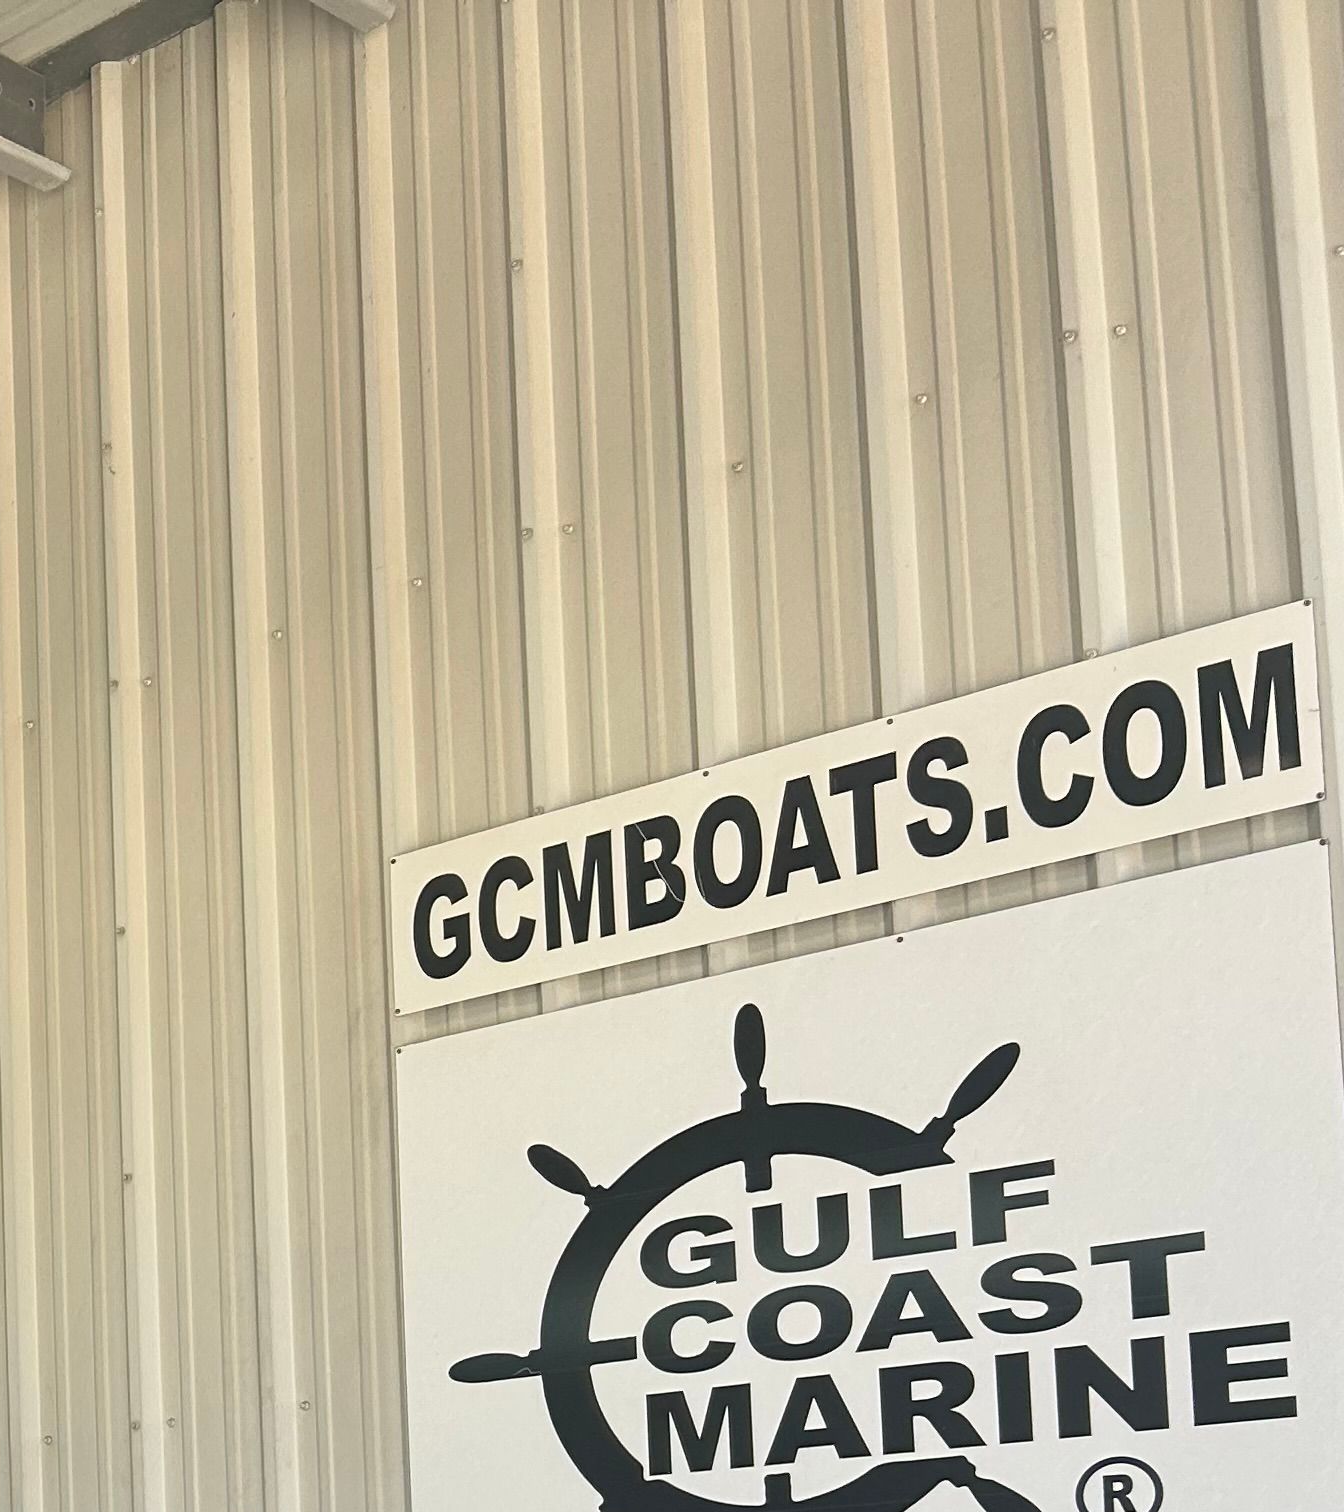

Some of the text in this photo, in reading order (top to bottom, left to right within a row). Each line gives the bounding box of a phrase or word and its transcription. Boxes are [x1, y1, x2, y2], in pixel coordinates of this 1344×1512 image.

[413, 642, 1302, 980] GCMBOATS.COM
[639, 1158, 1056, 1289] GULF
[642, 1230, 1206, 1374] COAST
[645, 1321, 1298, 1477] MARINE
